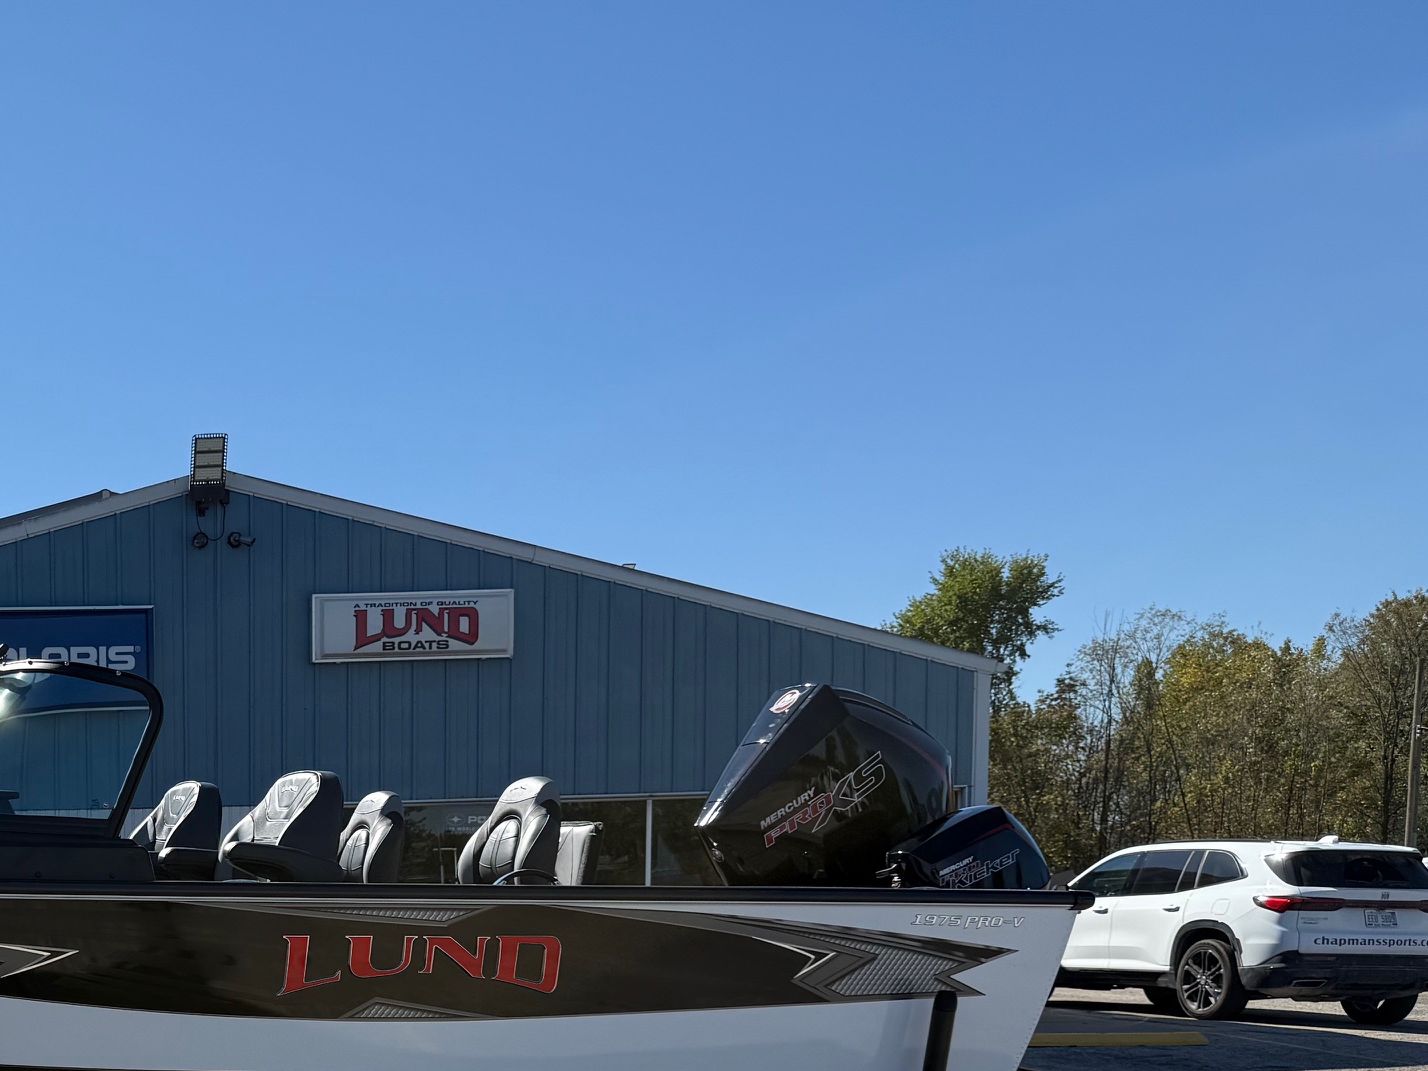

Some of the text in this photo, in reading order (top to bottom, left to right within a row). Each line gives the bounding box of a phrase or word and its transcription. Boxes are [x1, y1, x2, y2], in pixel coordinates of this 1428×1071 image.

[364, 601, 414, 609] TRADITION
[436, 599, 479, 607] QUALITY
[352, 607, 480, 652] LUND
[381, 640, 450, 651] BOATS
[760, 786, 816, 830] MERCURY
[939, 856, 974, 876] MERCURY
[911, 913, 1025, 929] 1975 PRO-V
[1313, 936, 1428, 947] chapmanssports.c
[275, 935, 562, 997] LUND
